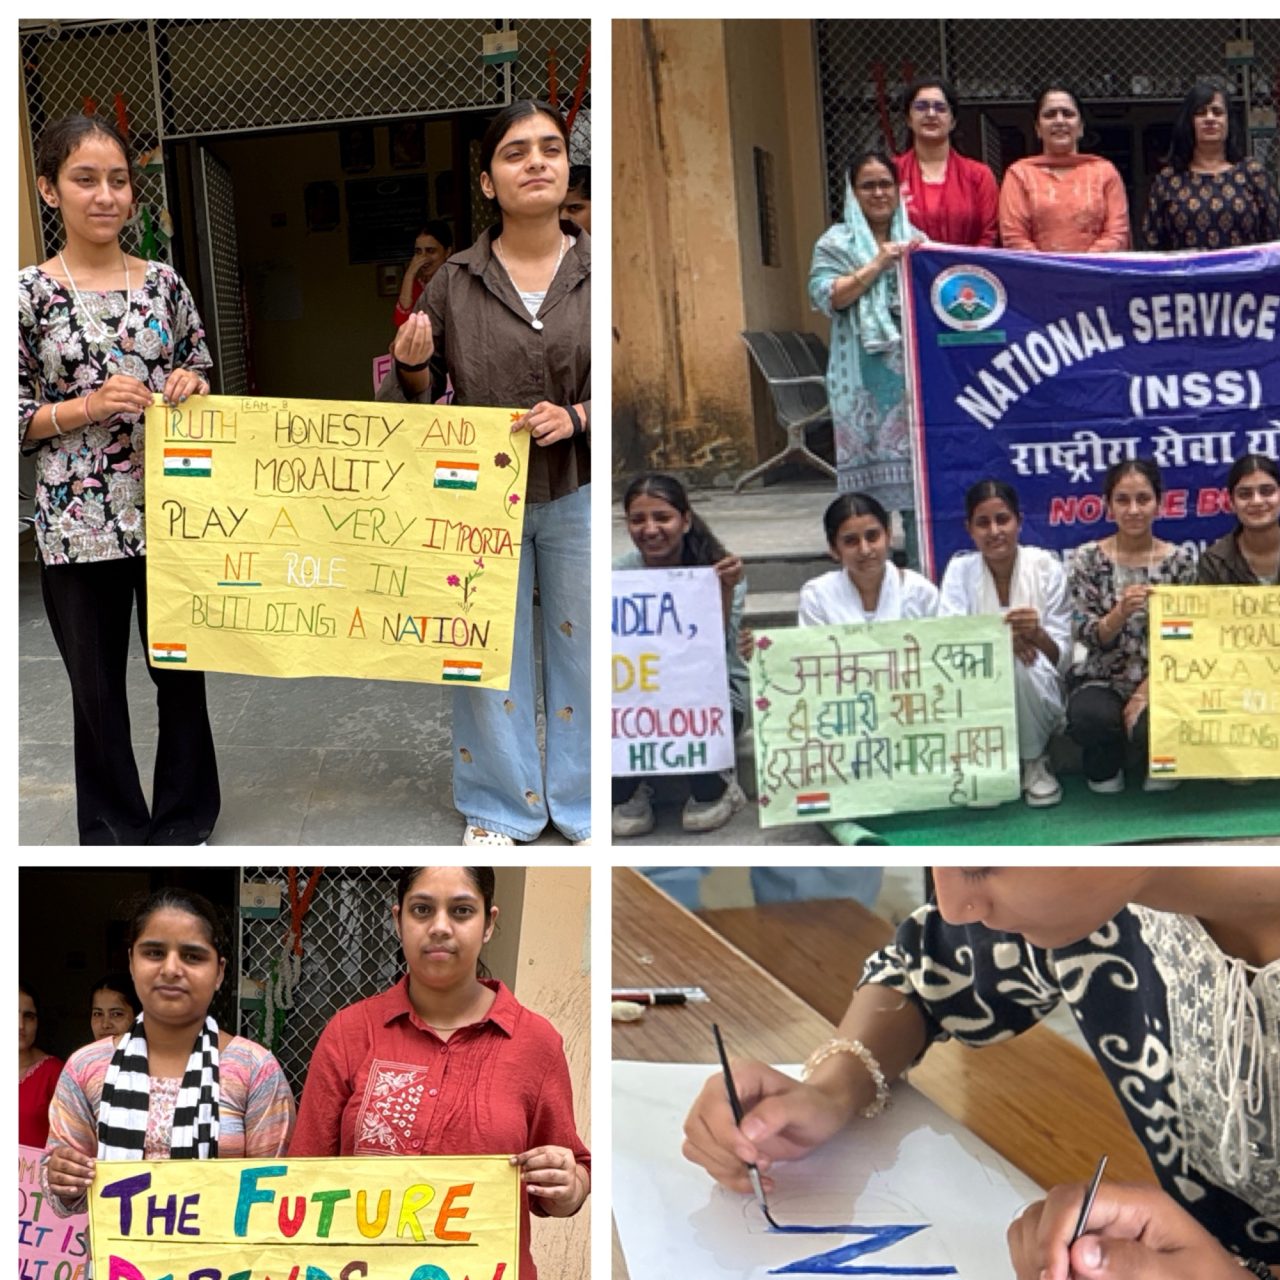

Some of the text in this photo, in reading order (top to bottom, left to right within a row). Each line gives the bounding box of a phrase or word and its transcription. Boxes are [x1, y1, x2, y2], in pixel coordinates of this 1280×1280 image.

[955, 306, 1124, 430] NATIONAL
[1130, 369, 1262, 416] (NSS)
[275, 412, 404, 448] HONESTY
[422, 418, 476, 447] AND
[1152, 426, 1234, 468] सेवा
[254, 457, 405, 493] MORALITY
[161, 500, 248, 539] PLAY
[268, 507, 299, 538] A
[322, 504, 417, 546] VERY
[224, 552, 408, 597] NT ROLE IN
[192, 595, 336, 636] BUILDING
[348, 606, 367, 638] A
[1160, 655, 1218, 683] PLAY
[629, 741, 707, 771] HIGH
[100, 1165, 475, 1243] THE FUTURE
